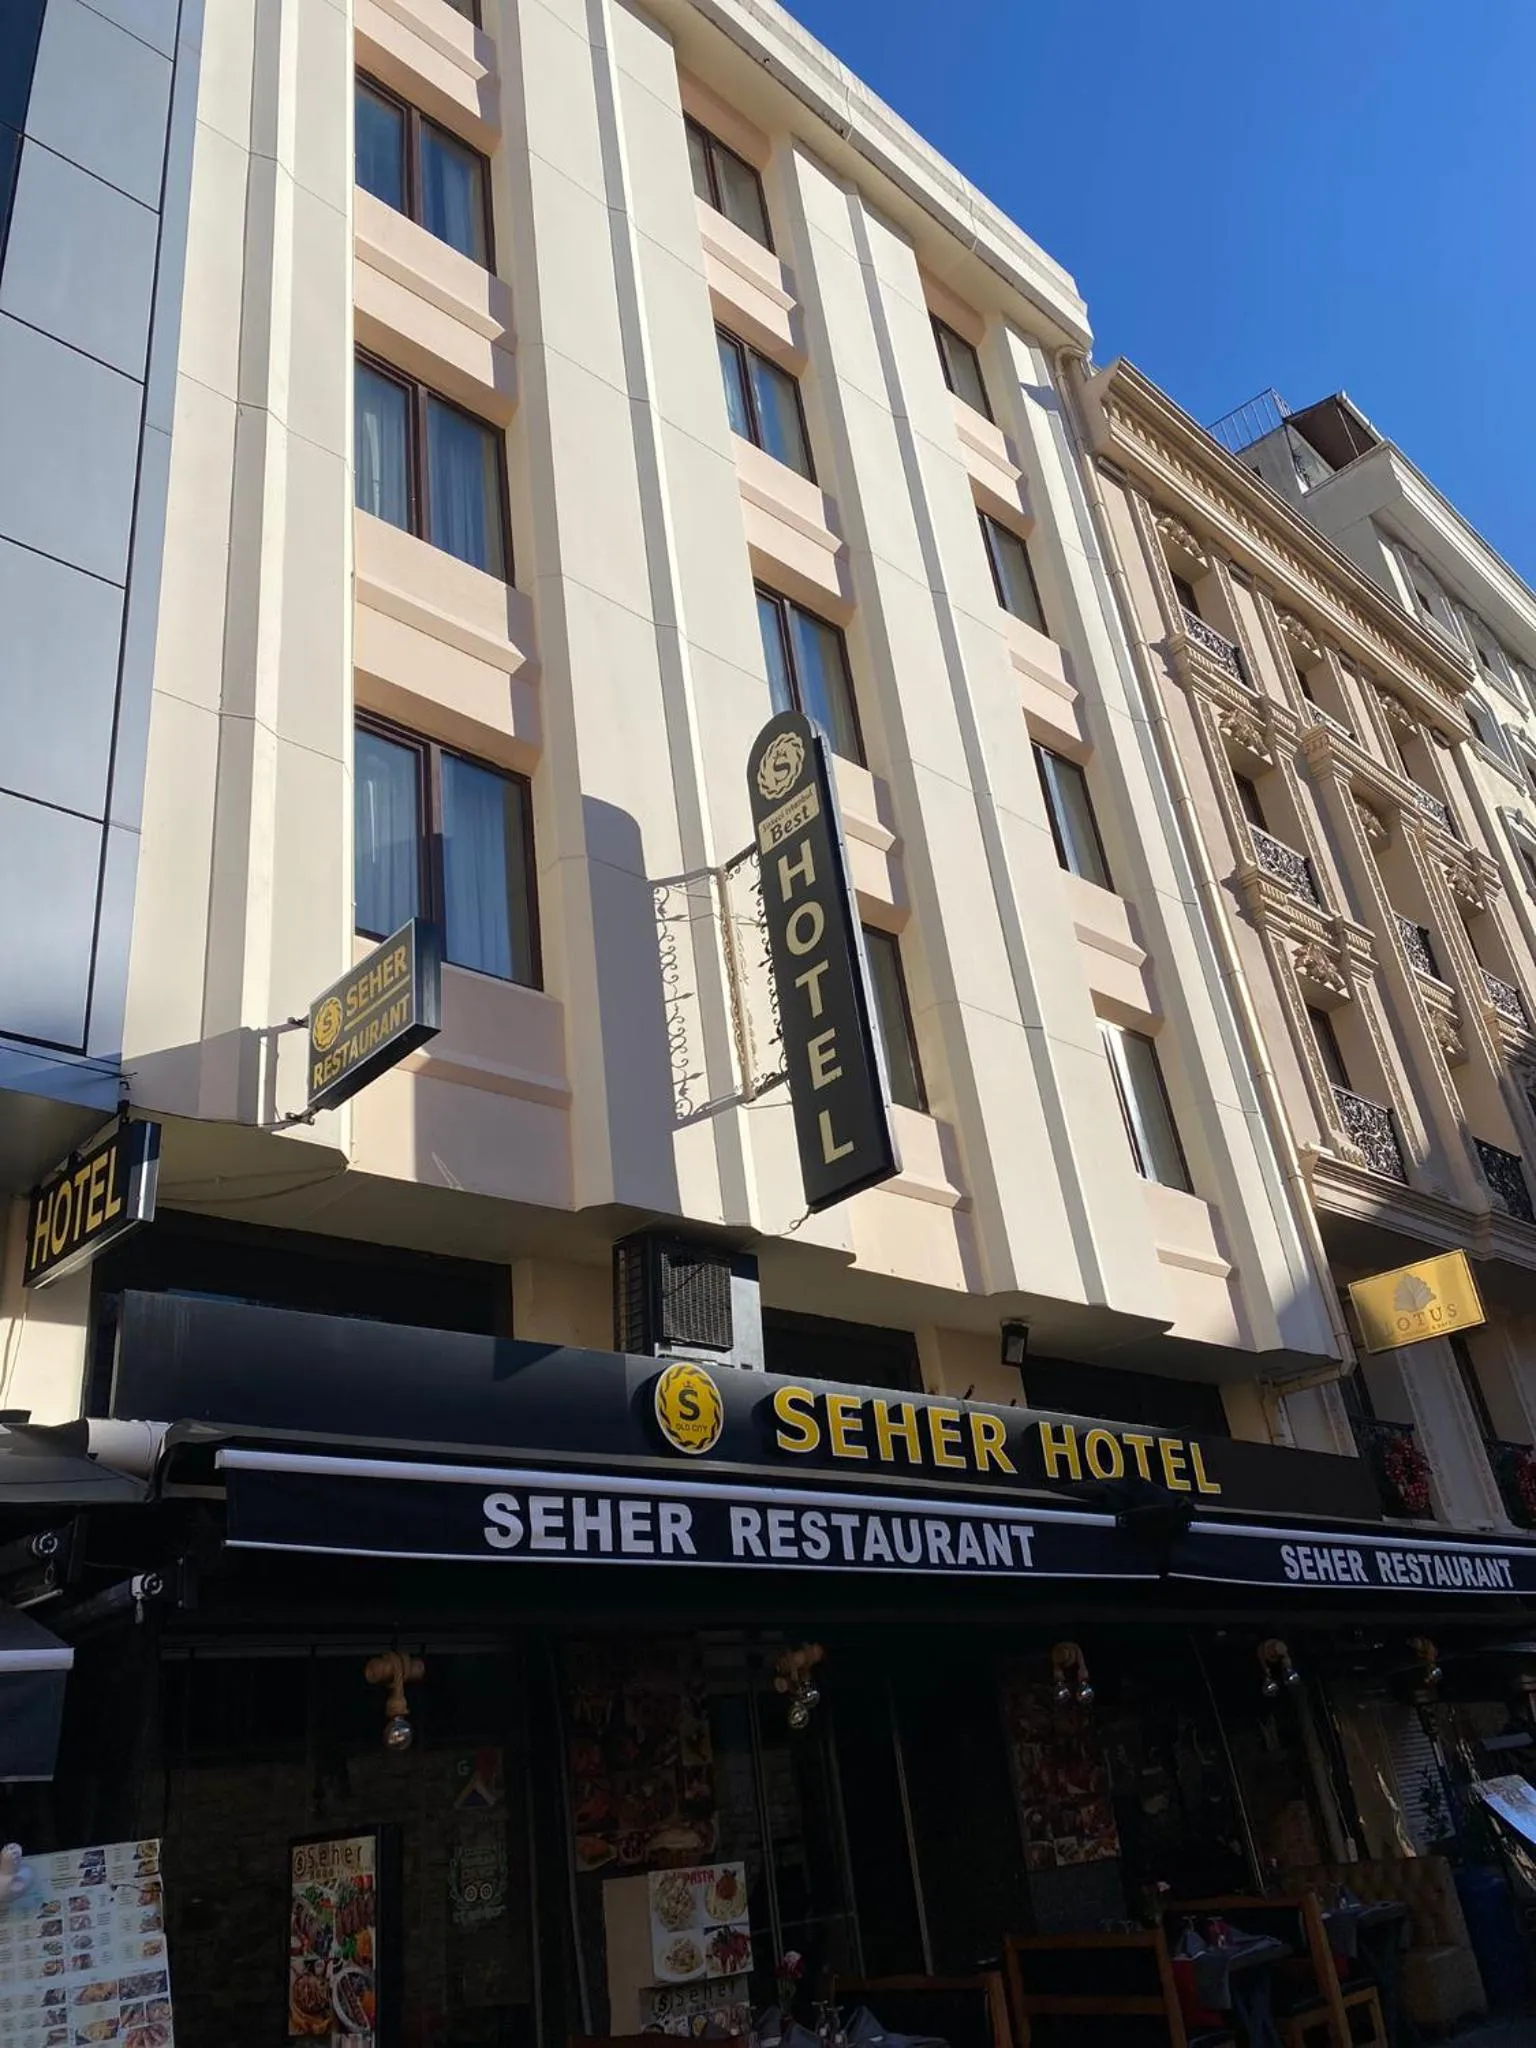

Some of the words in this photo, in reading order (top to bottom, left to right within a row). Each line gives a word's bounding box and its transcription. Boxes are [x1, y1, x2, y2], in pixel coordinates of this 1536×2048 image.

[770, 805, 810, 844] Best
[346, 944, 407, 1017] SEHER
[777, 837, 855, 1165] HOTEL
[312, 993, 411, 1090] RESTAURANT
[30, 1145, 122, 1271] HOTEL
[678, 1388, 701, 1422] S
[773, 1385, 1019, 1475] SEHER
[1036, 1420, 1222, 1495] HOTEL
[482, 1492, 697, 1555] SEHER
[729, 1506, 1035, 1567] RESTAURANT
[1280, 1544, 1369, 1583] SEHER
[1375, 1550, 1514, 1588] RESTAURANT
[307, 1843, 363, 1869] Seher
